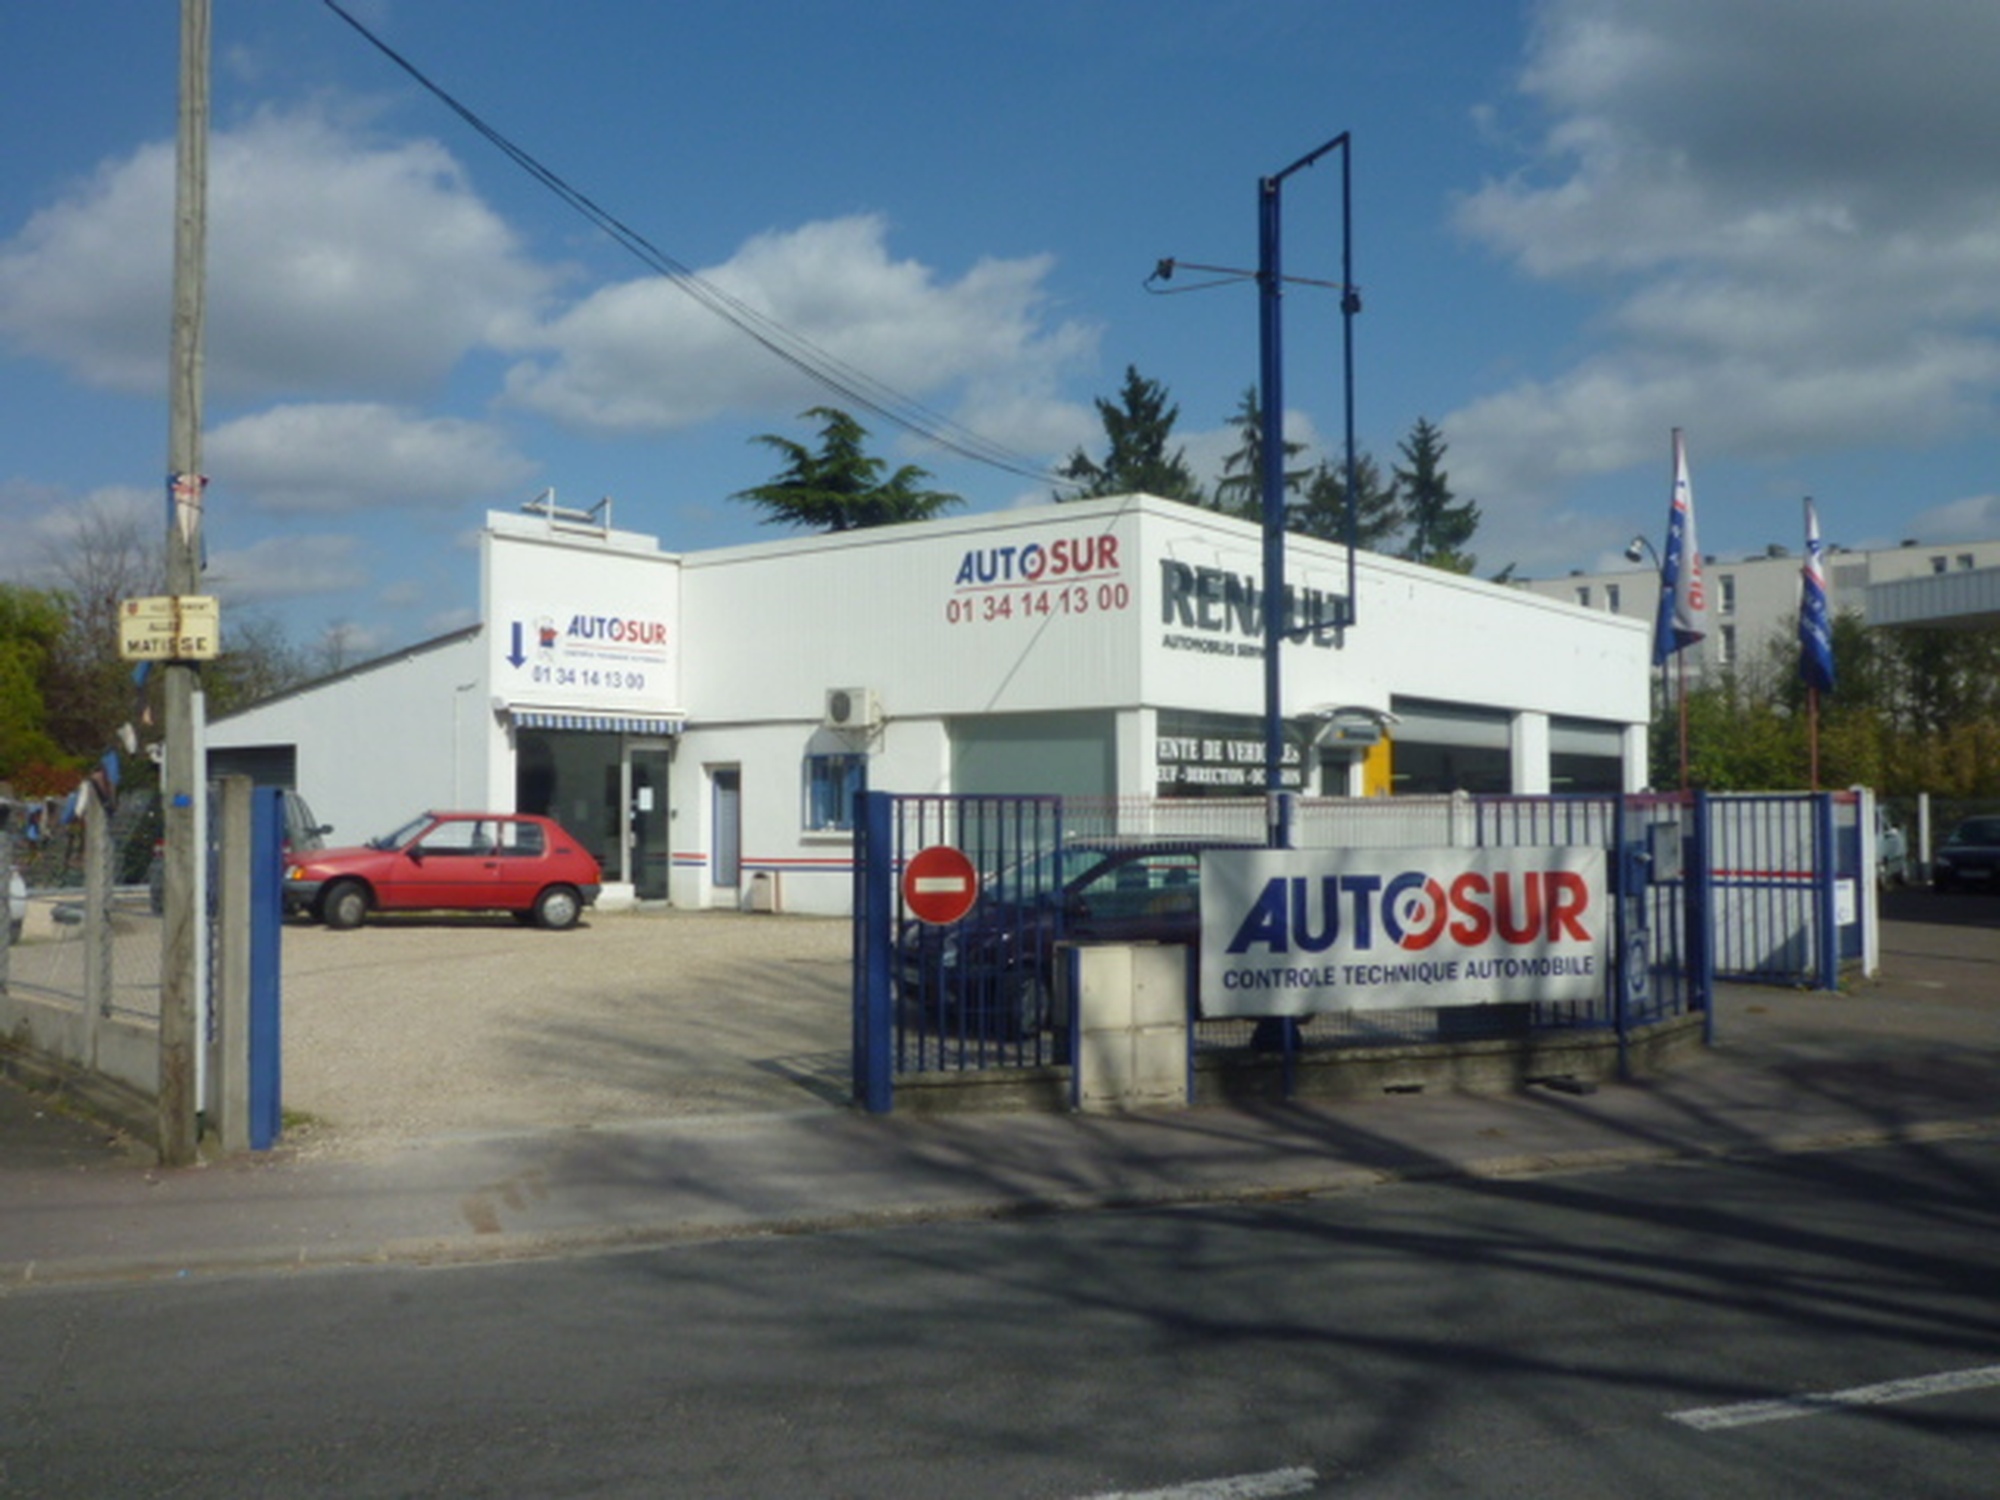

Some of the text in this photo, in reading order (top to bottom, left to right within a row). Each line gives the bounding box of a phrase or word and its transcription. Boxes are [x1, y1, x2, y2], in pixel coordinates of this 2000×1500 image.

[955, 534, 1120, 585] AUTOSUR
[946, 583, 1129, 624] 01 34 14 13 00
[1159, 558, 1349, 650] RENULT
[566, 614, 667, 645] AUTOSUR
[532, 665, 551, 683] 01
[556, 667, 576, 685] 34
[604, 671, 622, 689] 13
[1225, 870, 1593, 954] AUTOSUR
[1222, 955, 1595, 990] CONTROLE TECHNIQUE AUTOMOBILE
